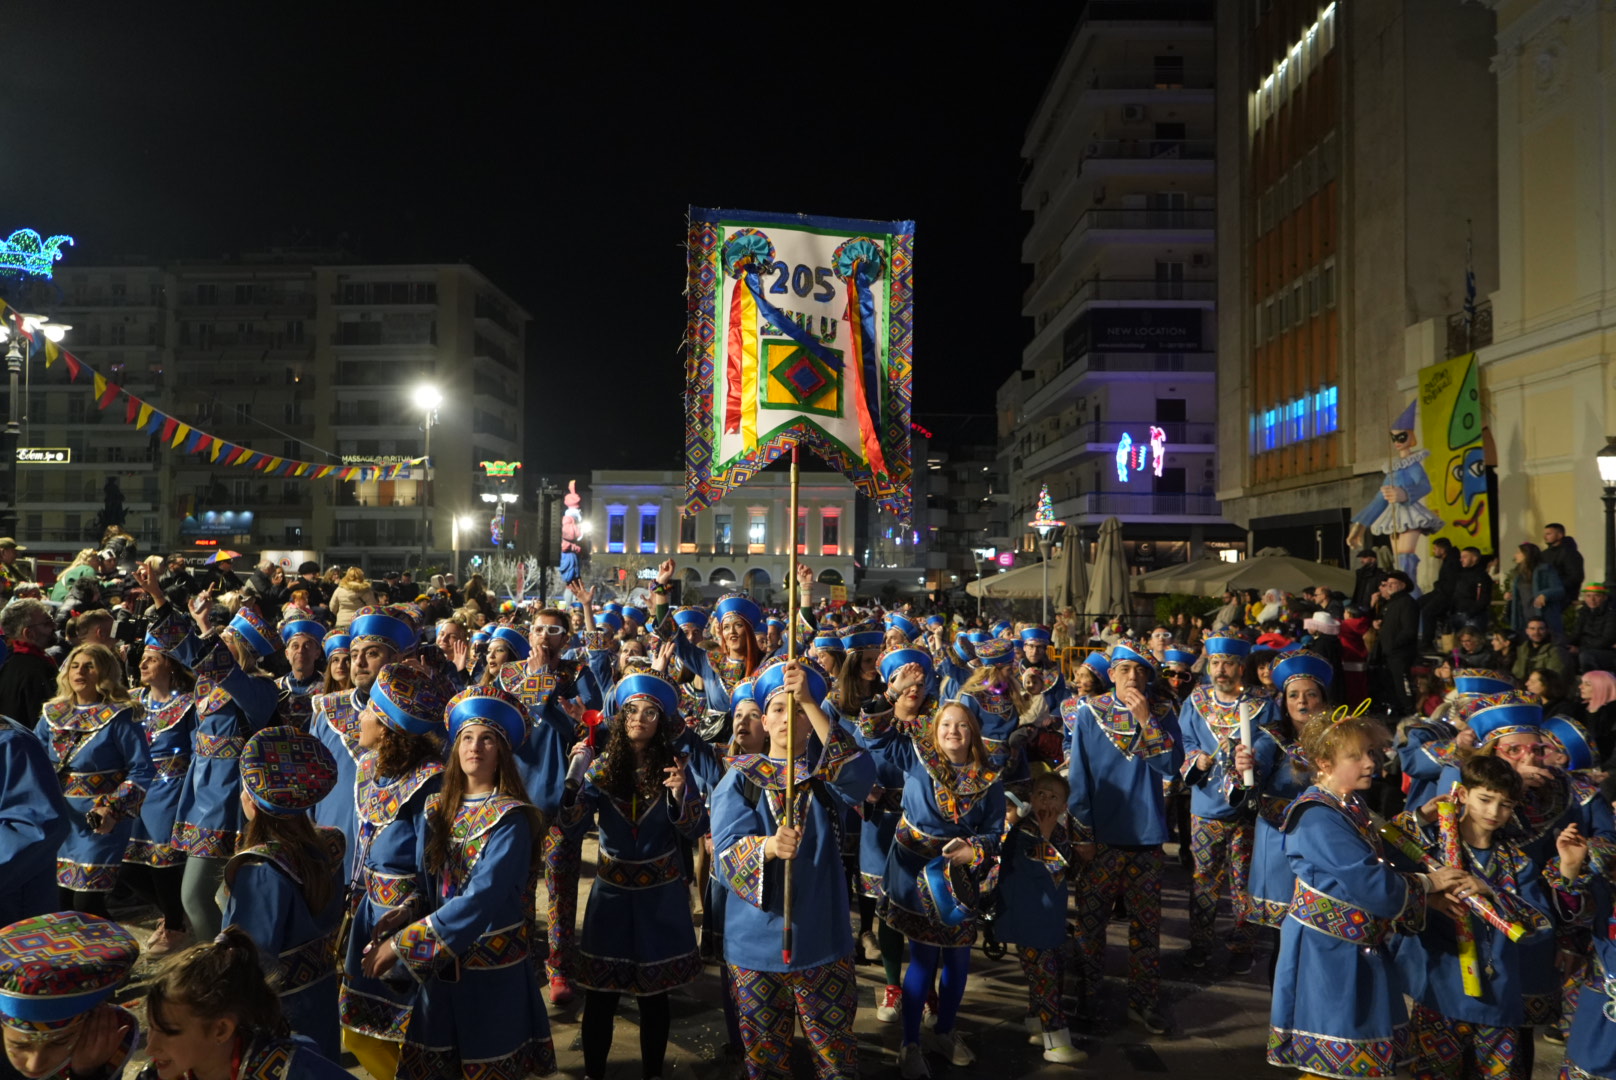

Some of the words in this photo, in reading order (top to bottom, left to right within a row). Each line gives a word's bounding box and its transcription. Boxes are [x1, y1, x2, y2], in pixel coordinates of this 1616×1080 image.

[769, 261, 836, 303] 205
[1107, 327, 1132, 336] NEW
[1135, 327, 1187, 336] LOCATION
[341, 455, 374, 463] MASSAGE
